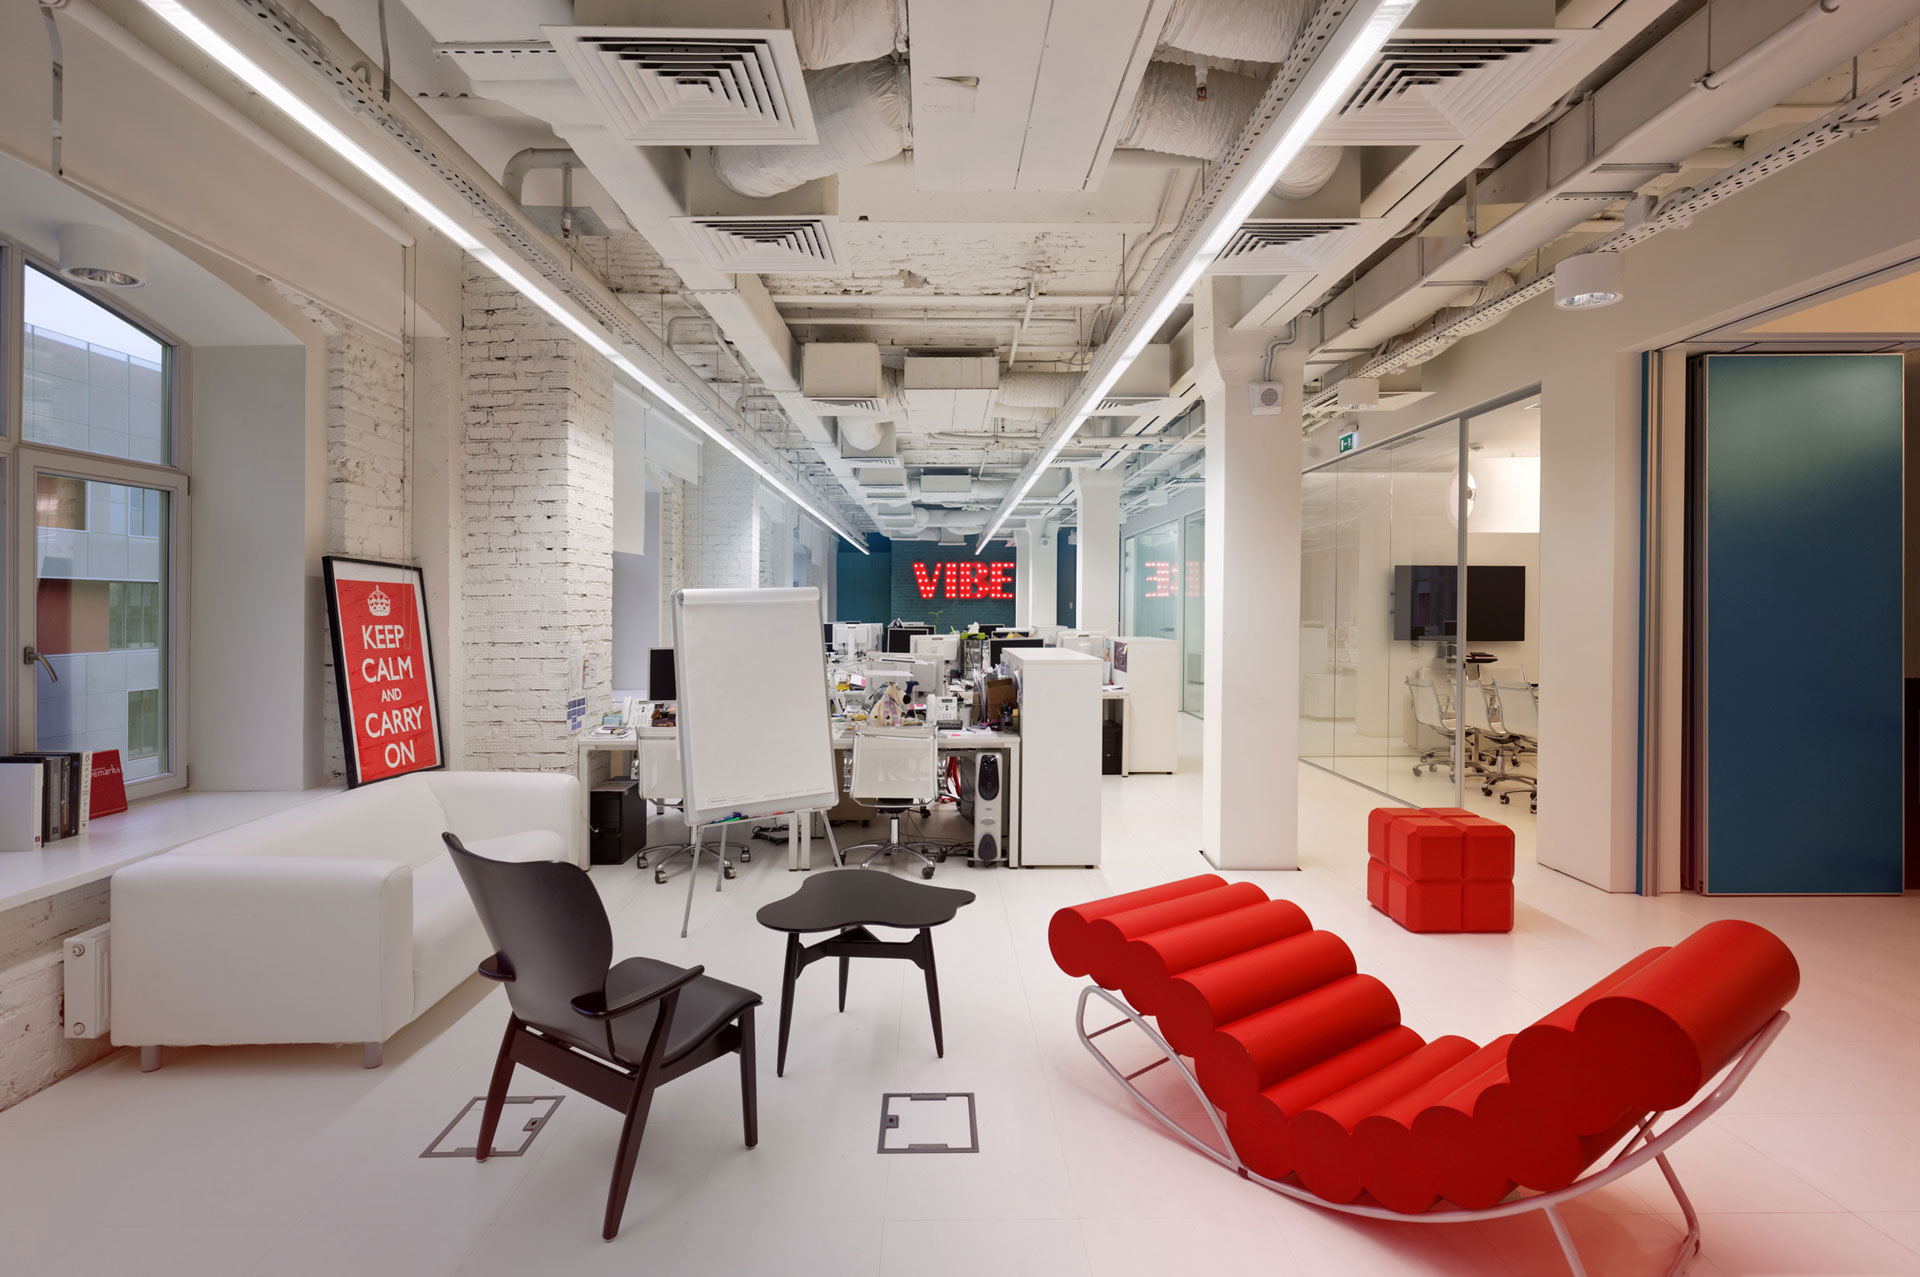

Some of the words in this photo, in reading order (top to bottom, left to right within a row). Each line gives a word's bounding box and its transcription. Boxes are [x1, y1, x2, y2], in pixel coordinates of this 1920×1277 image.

[913, 562, 1015, 599] VIBE
[362, 625, 404, 649] KEEP
[362, 656, 413, 683] CALM
[381, 688, 402, 702] AND
[365, 706, 423, 738] CARRY
[385, 740, 415, 768] ON
